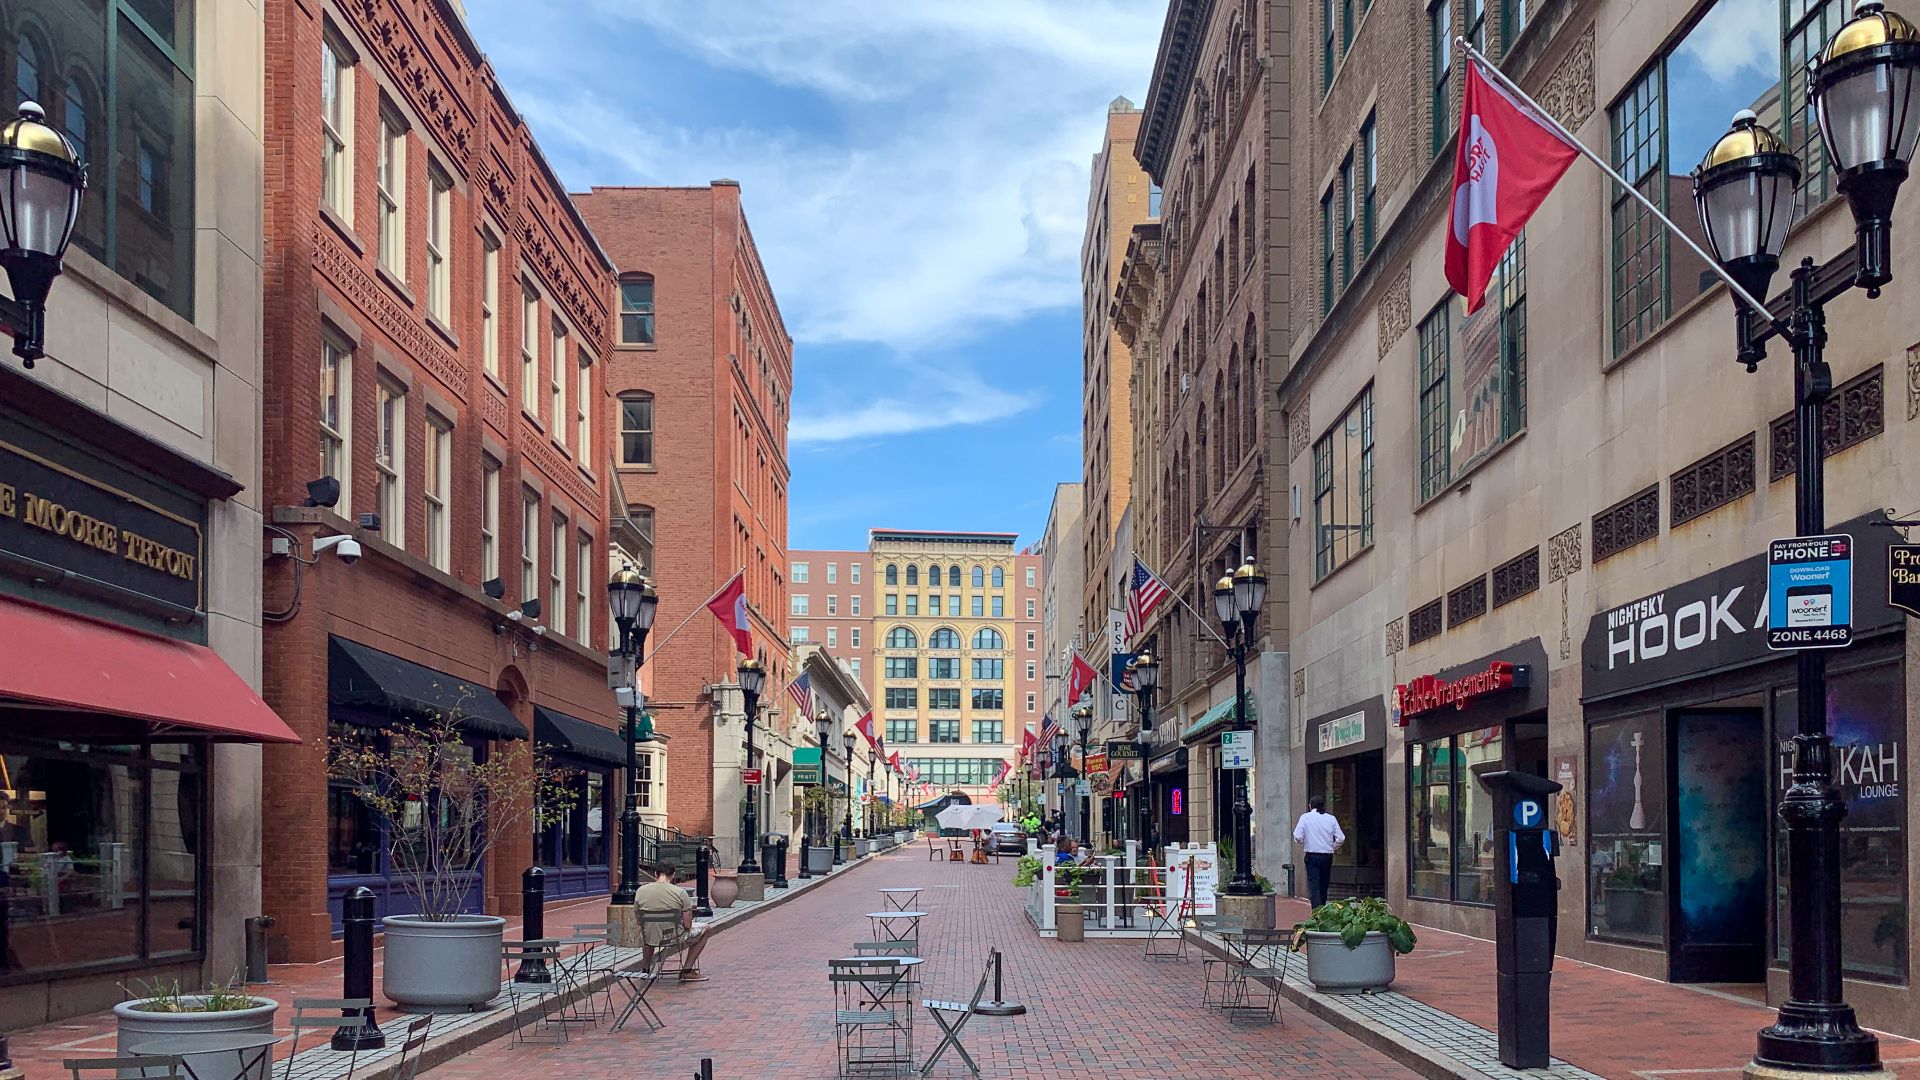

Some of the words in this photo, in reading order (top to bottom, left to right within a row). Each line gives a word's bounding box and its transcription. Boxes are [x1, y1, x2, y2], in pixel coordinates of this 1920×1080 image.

[23, 492, 117, 553] MOORE
[122, 530, 195, 580] TRYON
[1774, 547, 1829, 561] PHONE
[1789, 566, 1831, 574] DOWNLOAD
[1790, 572, 1831, 581] Woonerf
[1608, 594, 1665, 630] NIGHTSKY
[1772, 630, 1811, 642] ZONE
[1814, 629, 1847, 640] 4468
[1403, 673, 1432, 716] Edible
[1430, 667, 1501, 711] Arrangements
[1225, 734, 1230, 744] 2
[1110, 750, 1139, 758] GOURMET
[1780, 741, 1899, 790] HKAH
[1860, 784, 1899, 799] LOUNGE
[1522, 801, 1538, 826] P
